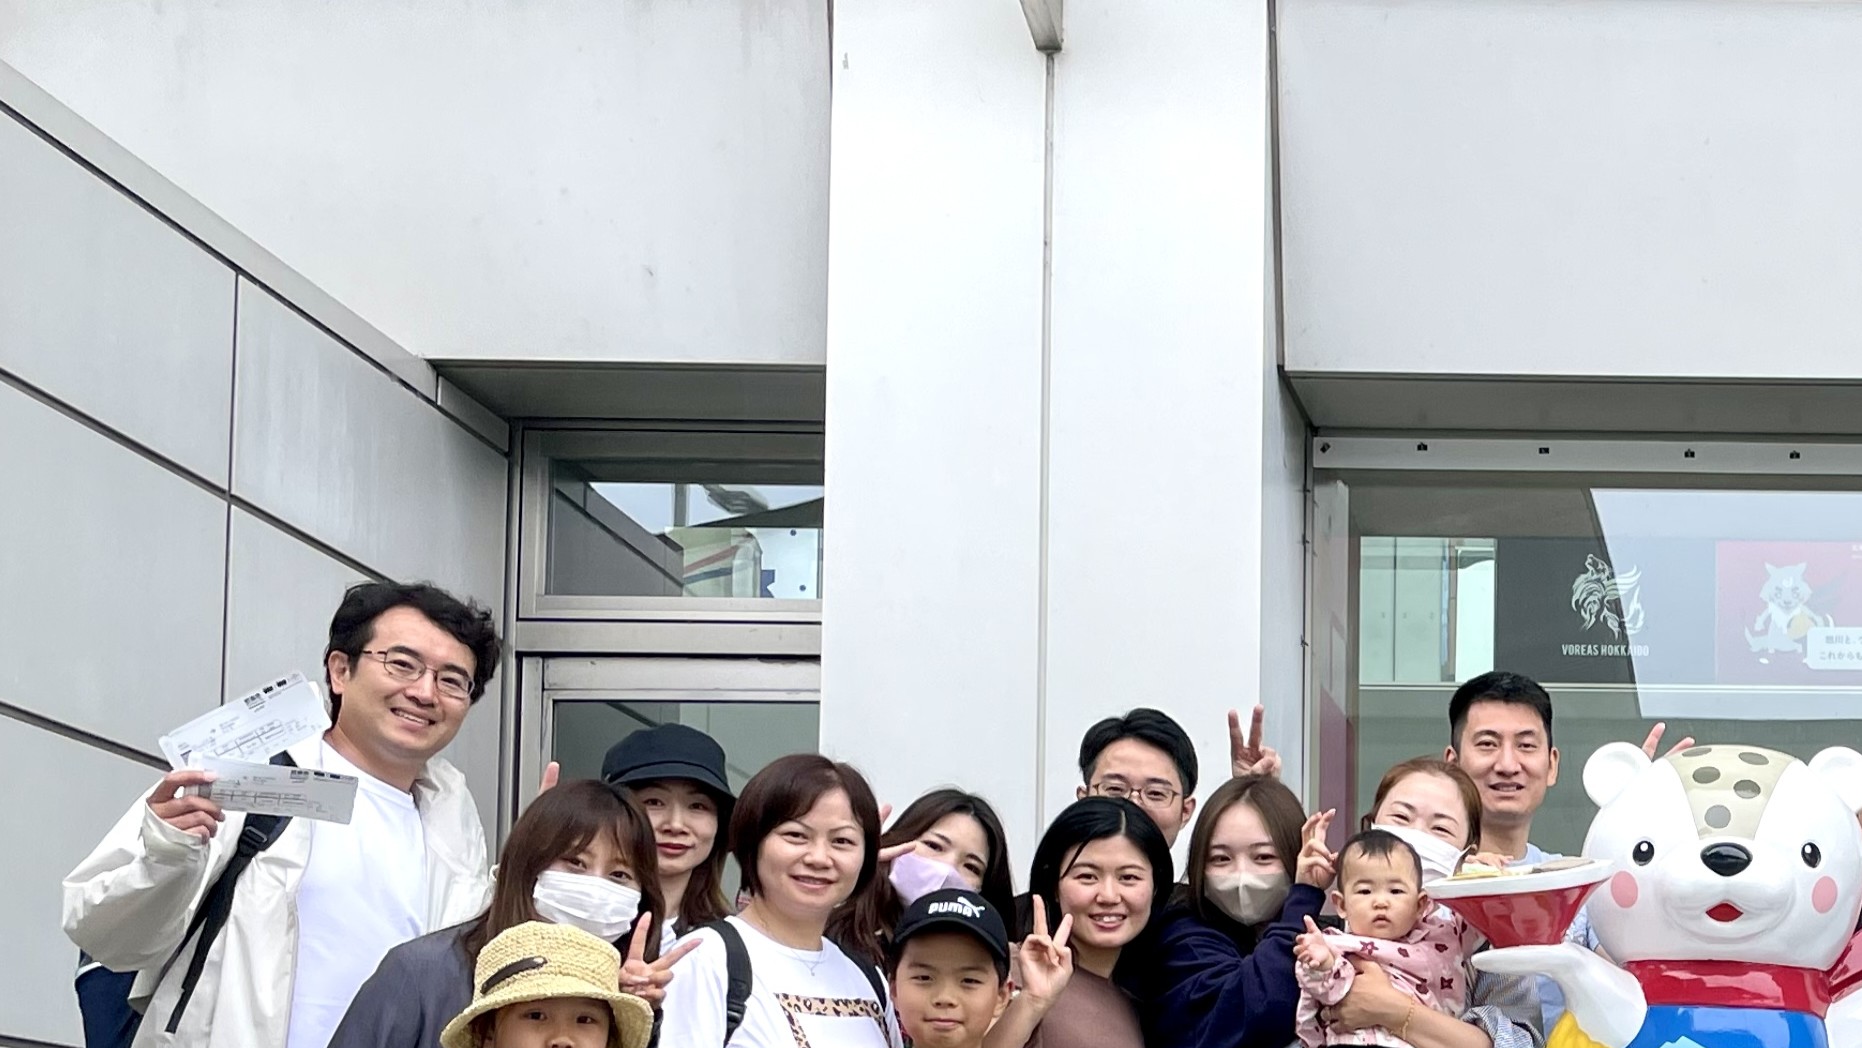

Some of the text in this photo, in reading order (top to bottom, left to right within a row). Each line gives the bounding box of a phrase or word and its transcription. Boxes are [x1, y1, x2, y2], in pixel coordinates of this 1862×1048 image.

[1562, 644, 1649, 657] VOREAS HOKKAIDO
[928, 901, 973, 918] PUMA
